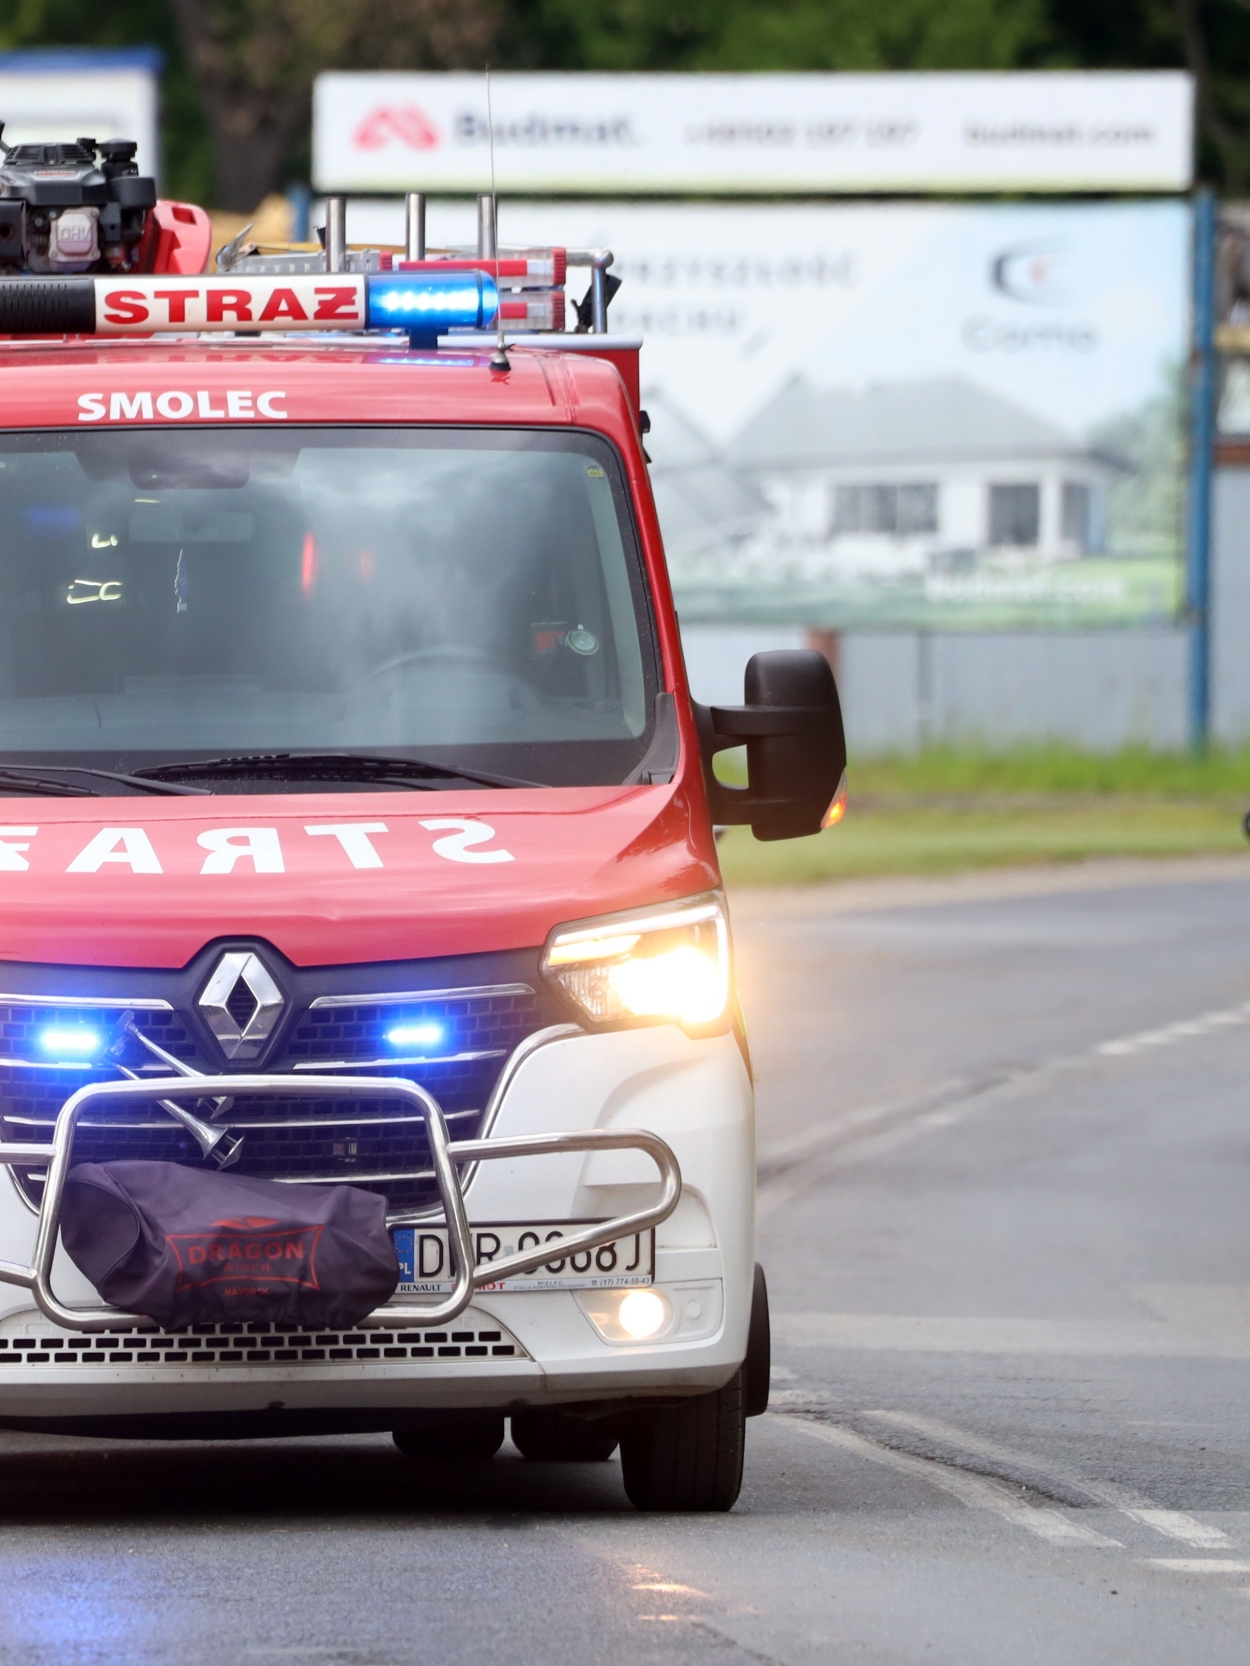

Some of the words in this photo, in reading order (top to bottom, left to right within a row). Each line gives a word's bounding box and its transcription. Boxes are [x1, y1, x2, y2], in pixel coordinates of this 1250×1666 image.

[77, 391, 288, 421] SMOLEC
[188, 1241, 305, 1265] DRAGON
[419, 1232, 503, 1278] DR
[400, 1284, 442, 1292] RENAULT
[616, 1277, 650, 1285] 774-58-43
